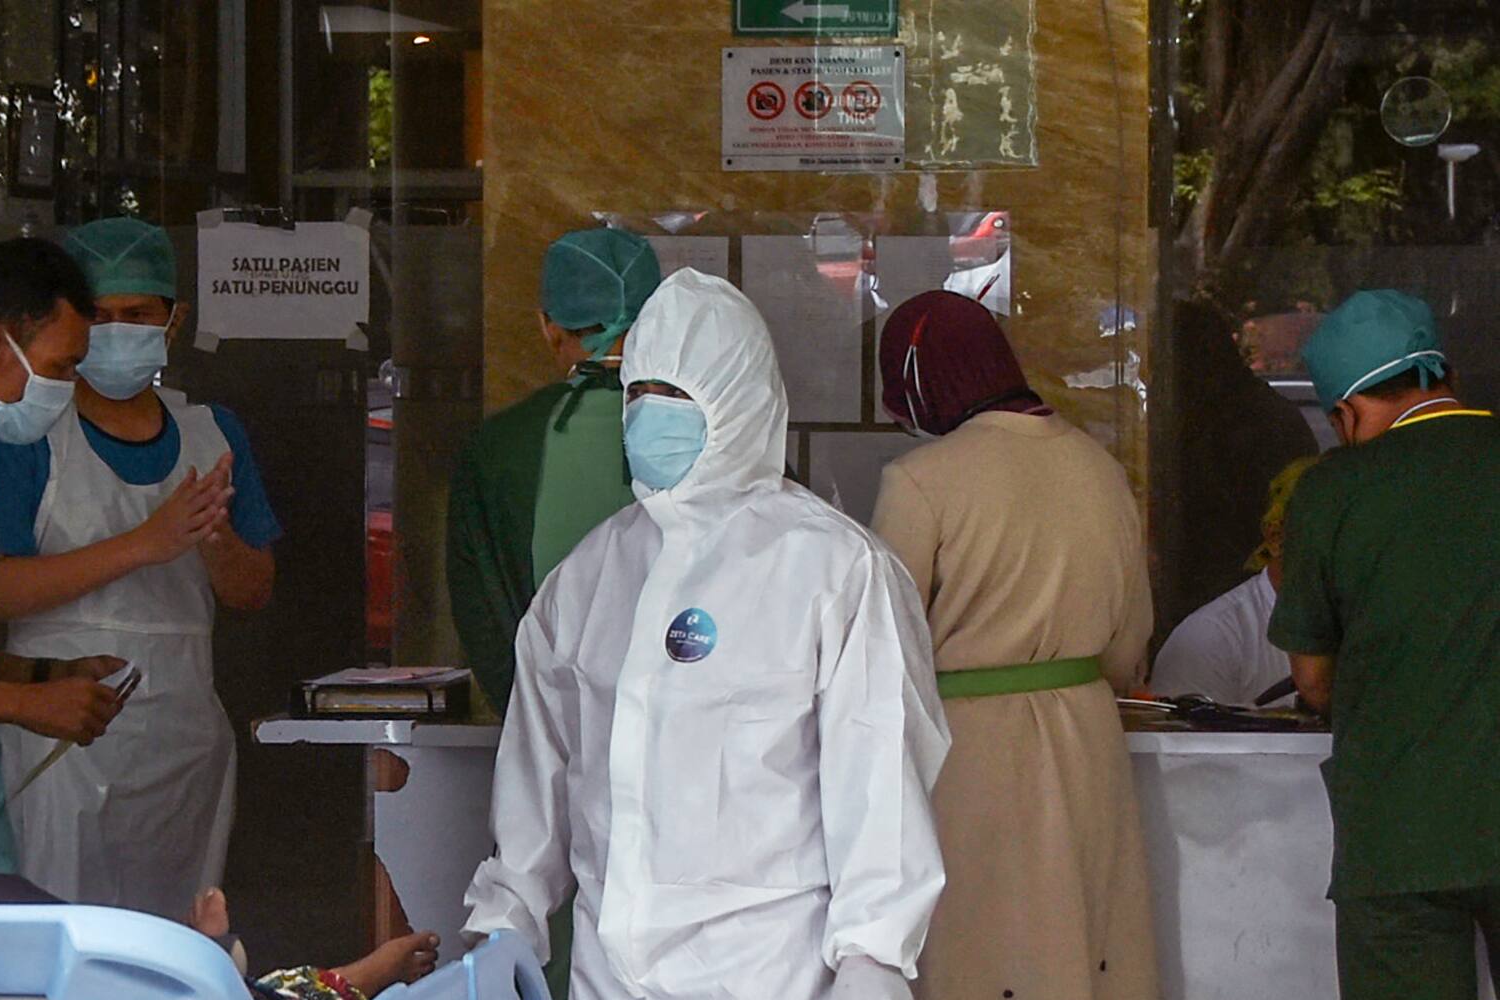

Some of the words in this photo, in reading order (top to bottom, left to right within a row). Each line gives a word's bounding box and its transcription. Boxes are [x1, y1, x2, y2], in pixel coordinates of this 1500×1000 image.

[750, 67, 780, 76] PASIEN
[231, 256, 274, 272] SATU
[279, 257, 341, 273] PASIEN
[211, 280, 254, 295] SATU
[258, 280, 359, 296] PENUNGGU
[669, 630, 687, 639] ZETA
